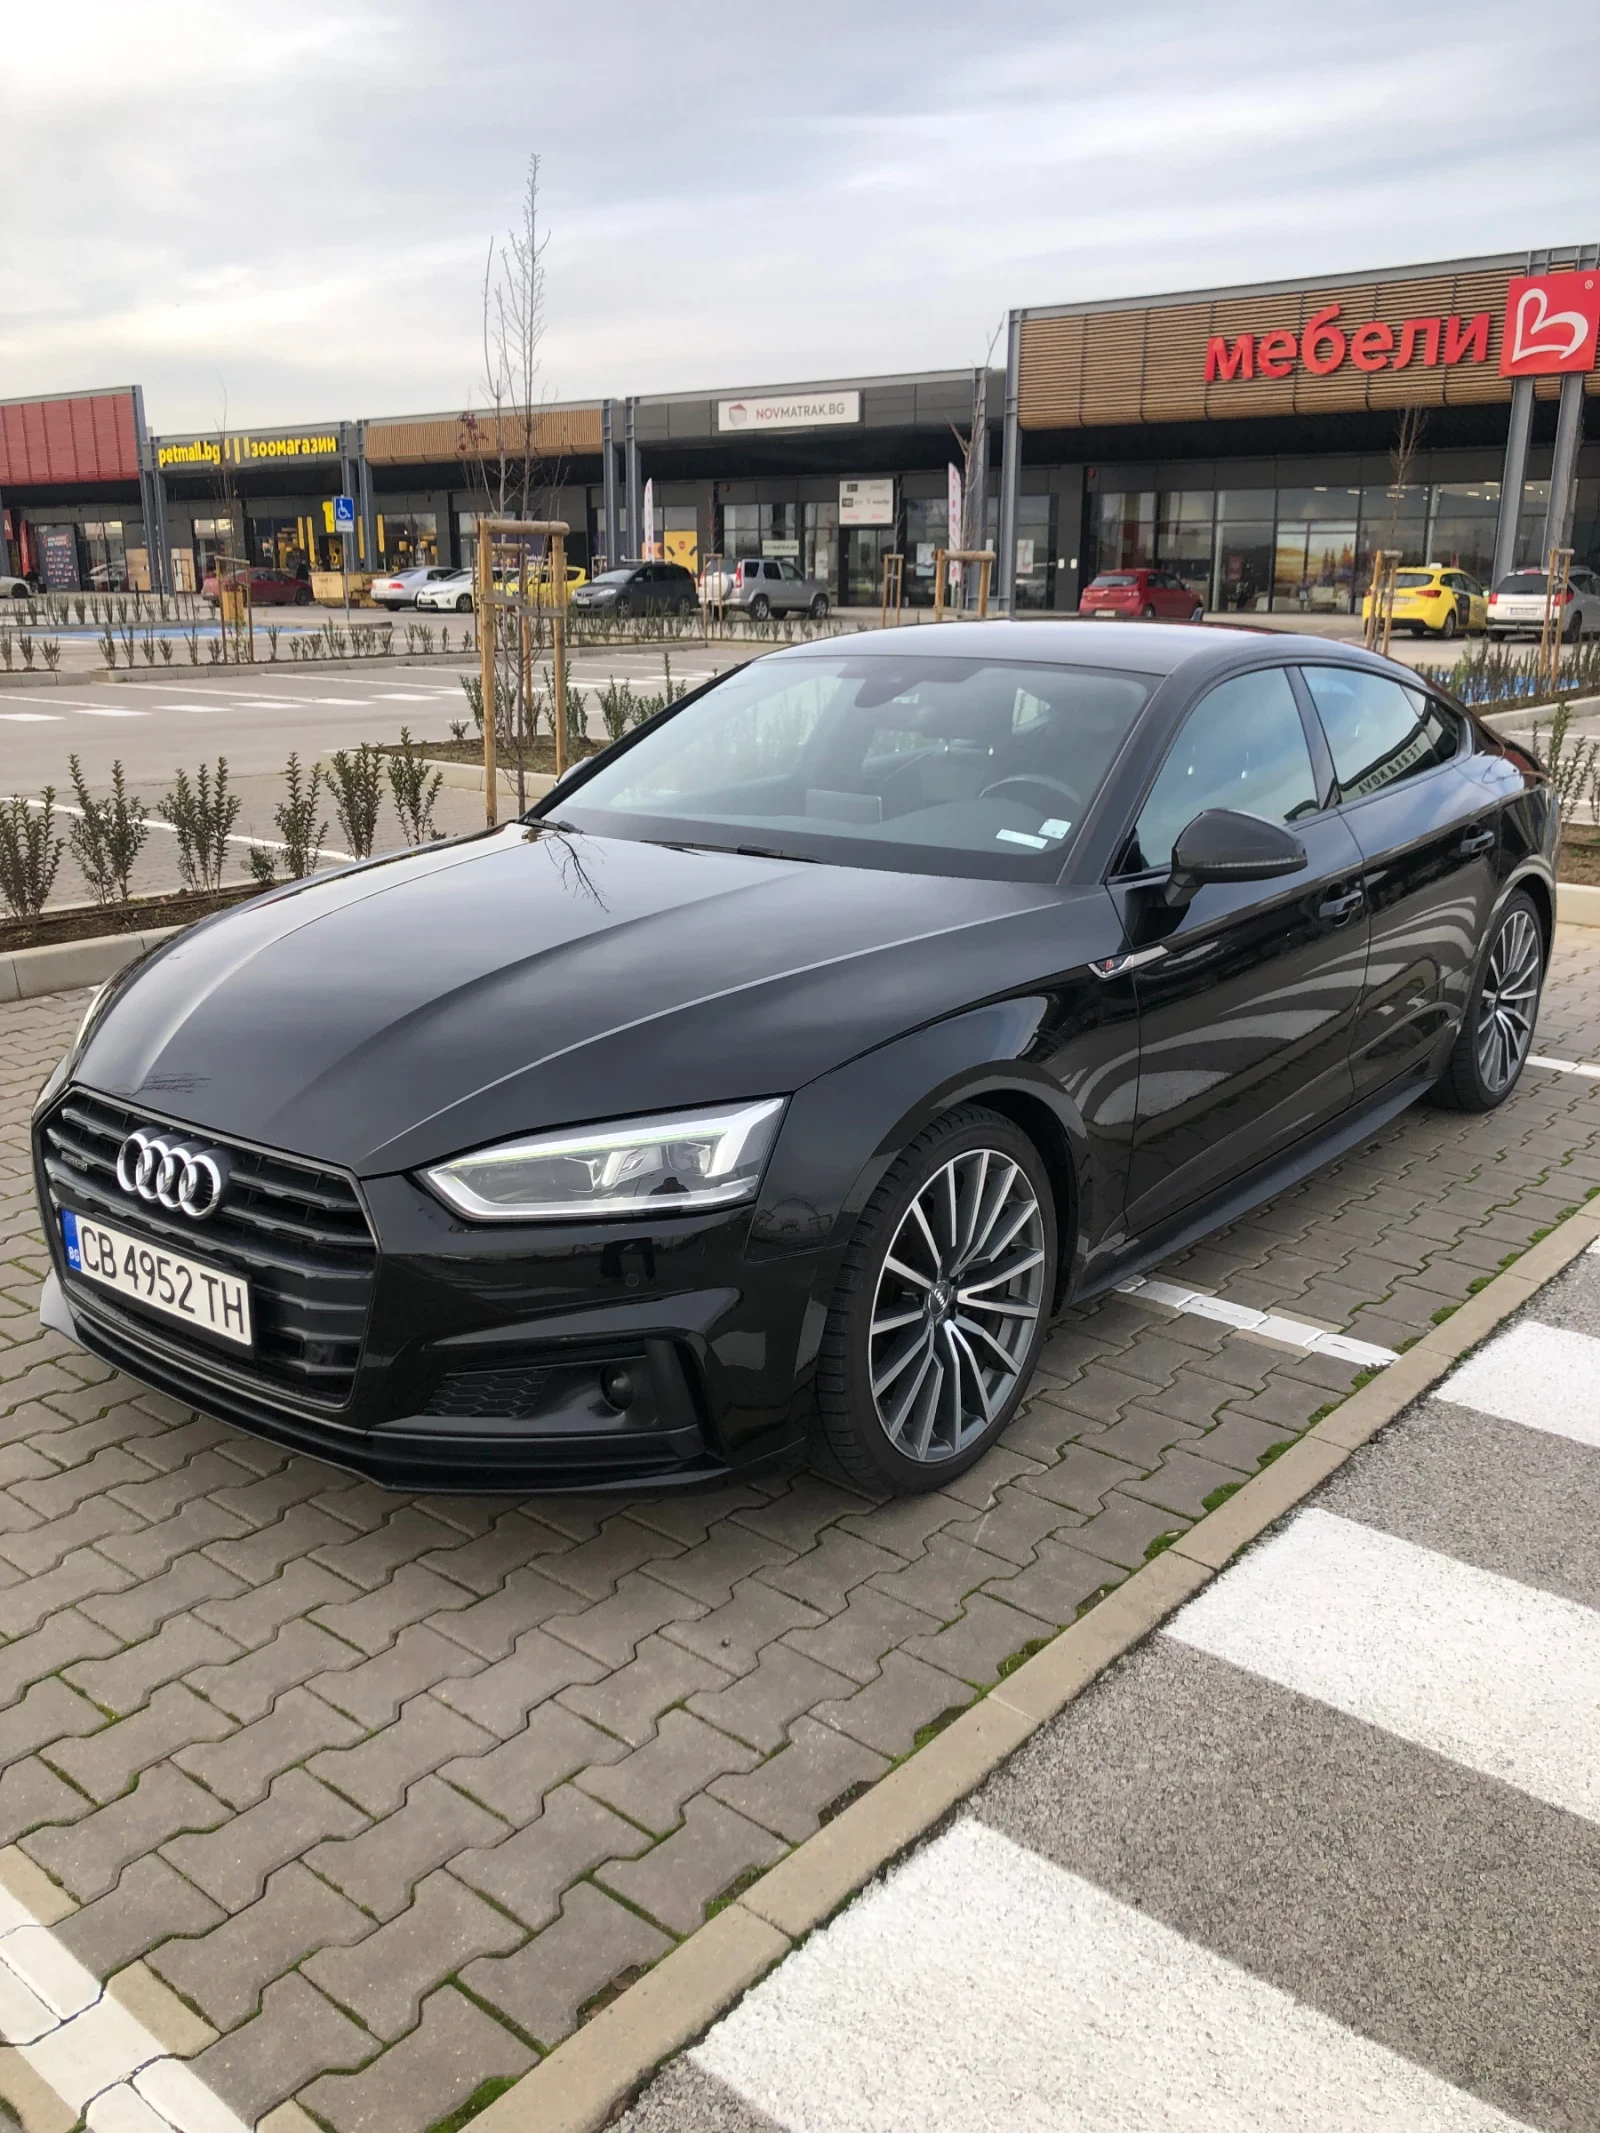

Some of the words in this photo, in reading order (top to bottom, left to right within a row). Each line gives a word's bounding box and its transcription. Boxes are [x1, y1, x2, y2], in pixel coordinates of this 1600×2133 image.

[1204, 303, 1491, 383] мебели
[756, 402, 846, 420] NOVMATRAK.BG
[158, 440, 221, 468] petmall.bg
[251, 436, 337, 458] зоомагазин
[68, 1246, 80, 1263] BG
[81, 1225, 117, 1280] CB
[123, 1244, 195, 1315] 4952
[199, 1273, 245, 1335] TH
